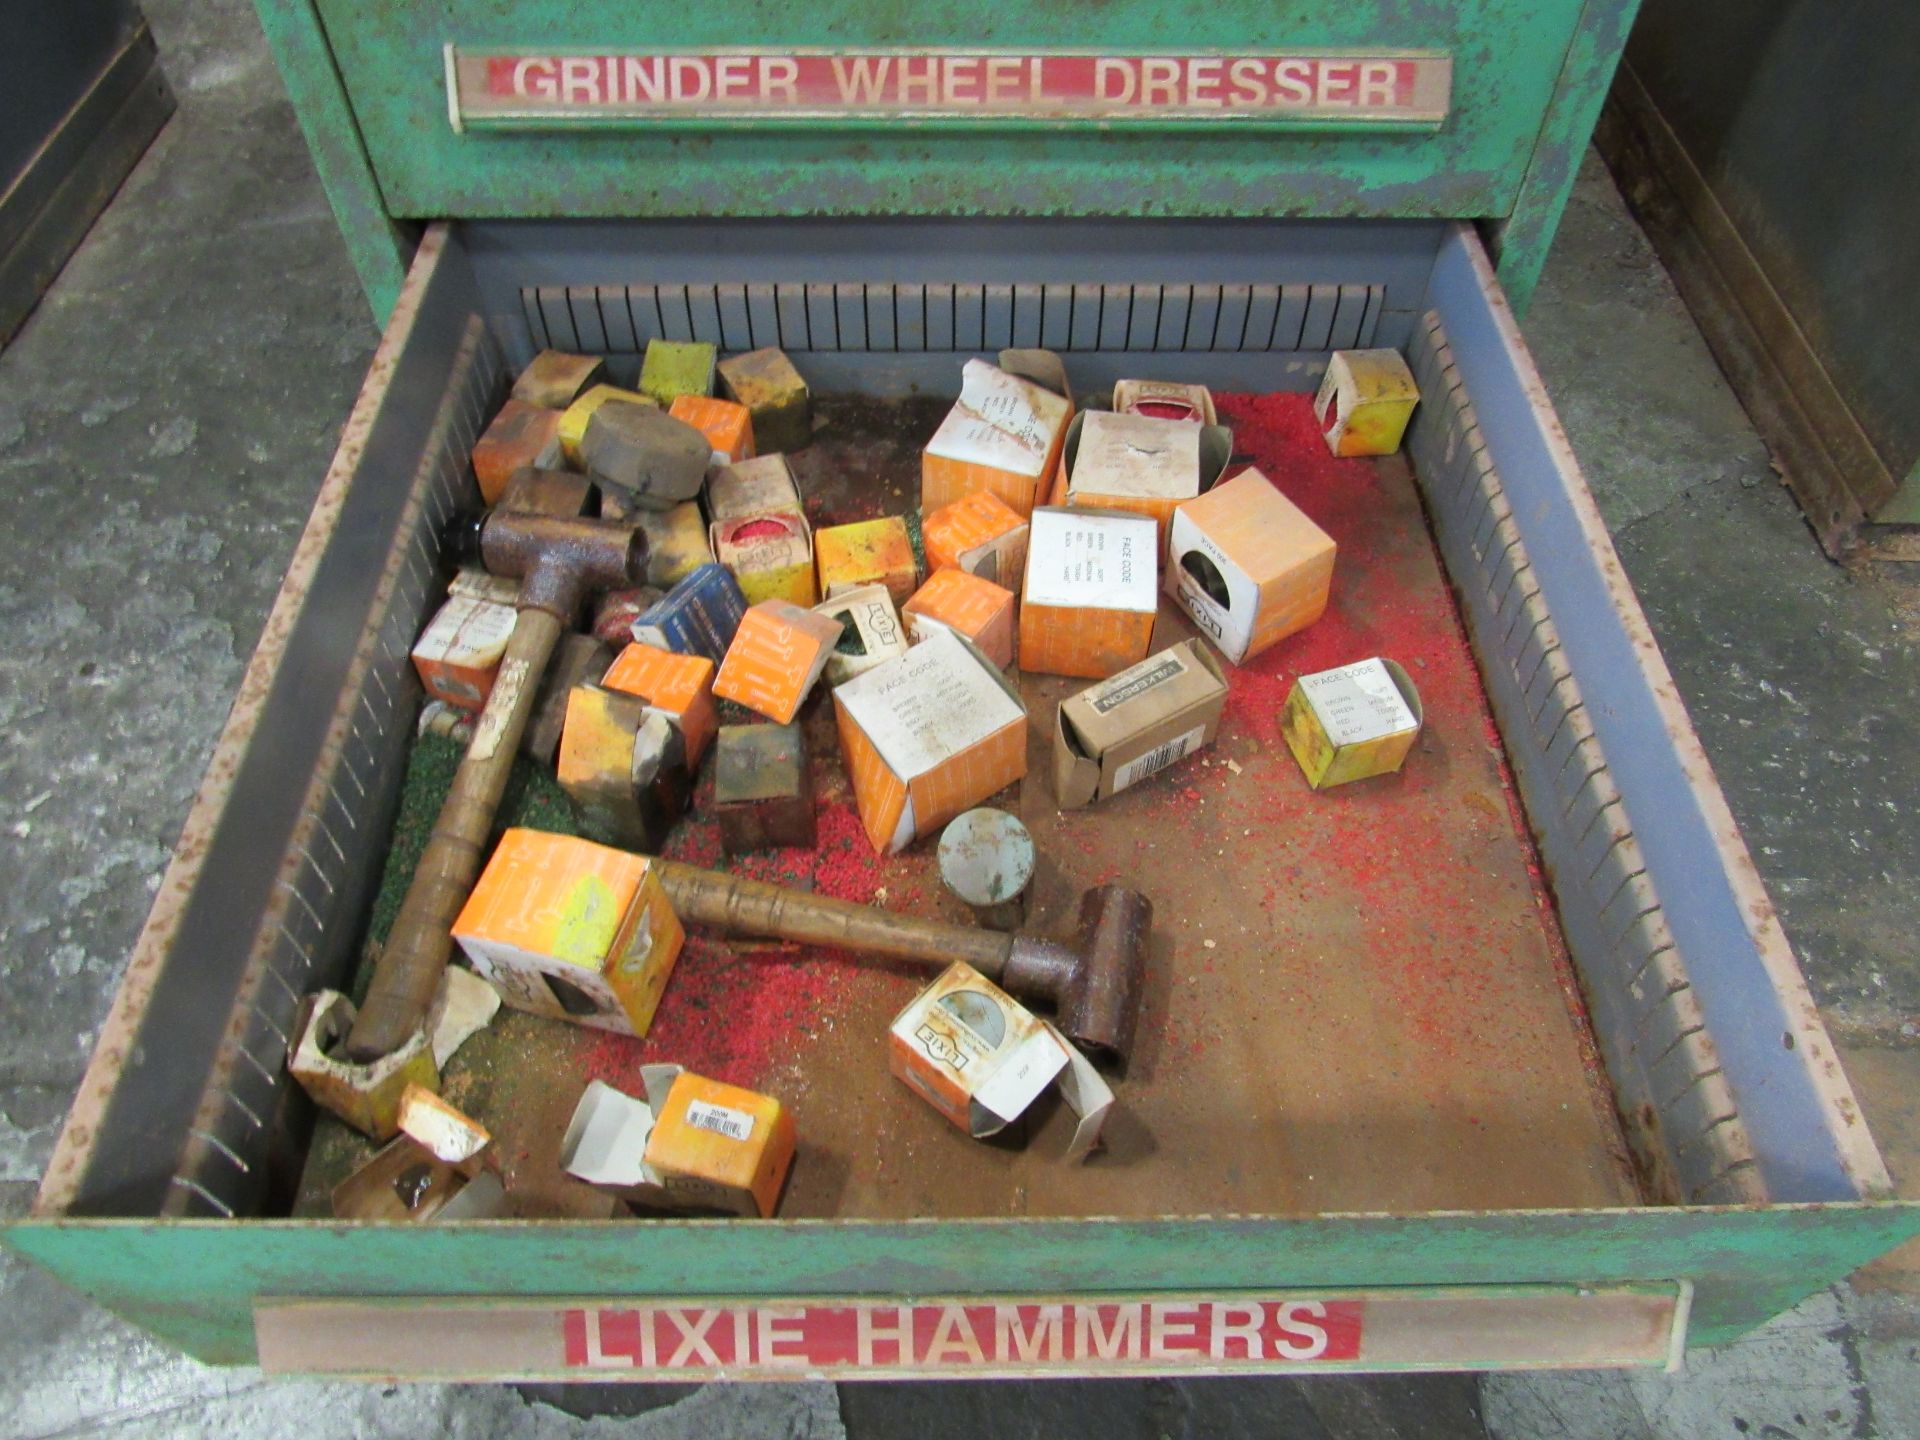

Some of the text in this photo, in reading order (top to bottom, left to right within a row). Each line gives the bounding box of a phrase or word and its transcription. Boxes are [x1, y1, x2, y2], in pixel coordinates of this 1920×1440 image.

[512, 56, 1398, 108] GRINDER WHEEL DRESSER
[1121, 537, 1132, 583] FACE CODE
[873, 608, 892, 639] LIXIE
[1103, 664, 1178, 708] WILKERSON
[1312, 665, 1376, 687] FACE CODE
[924, 1034, 959, 1063] LIXIE
[582, 1299, 1328, 1367] LIXIE HAMMERS
